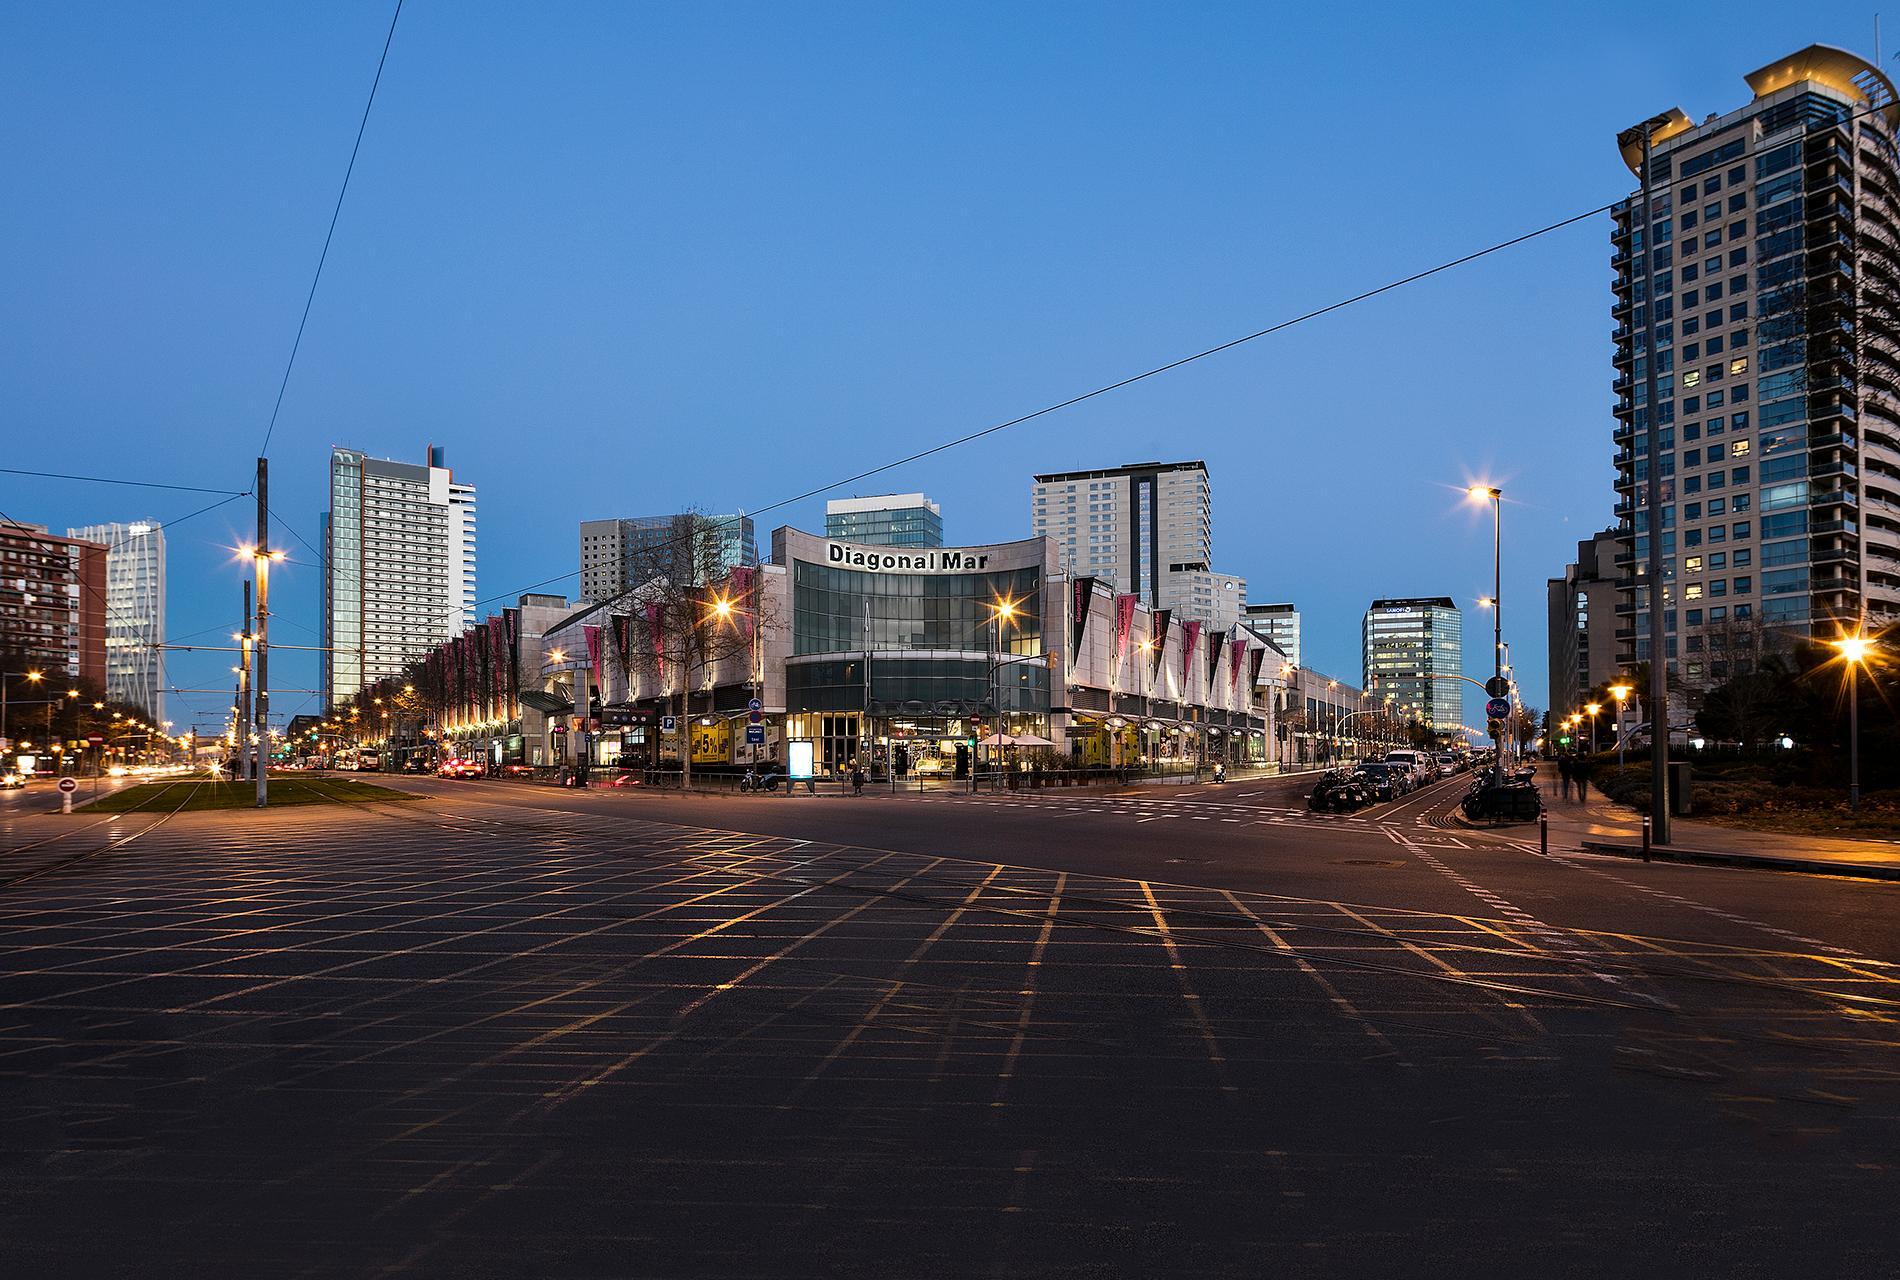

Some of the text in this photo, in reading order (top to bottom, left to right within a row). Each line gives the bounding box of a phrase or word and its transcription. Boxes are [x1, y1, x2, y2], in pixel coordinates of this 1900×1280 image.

[829, 543, 988, 570] Diagonal Mar
[666, 719, 673, 728] P
